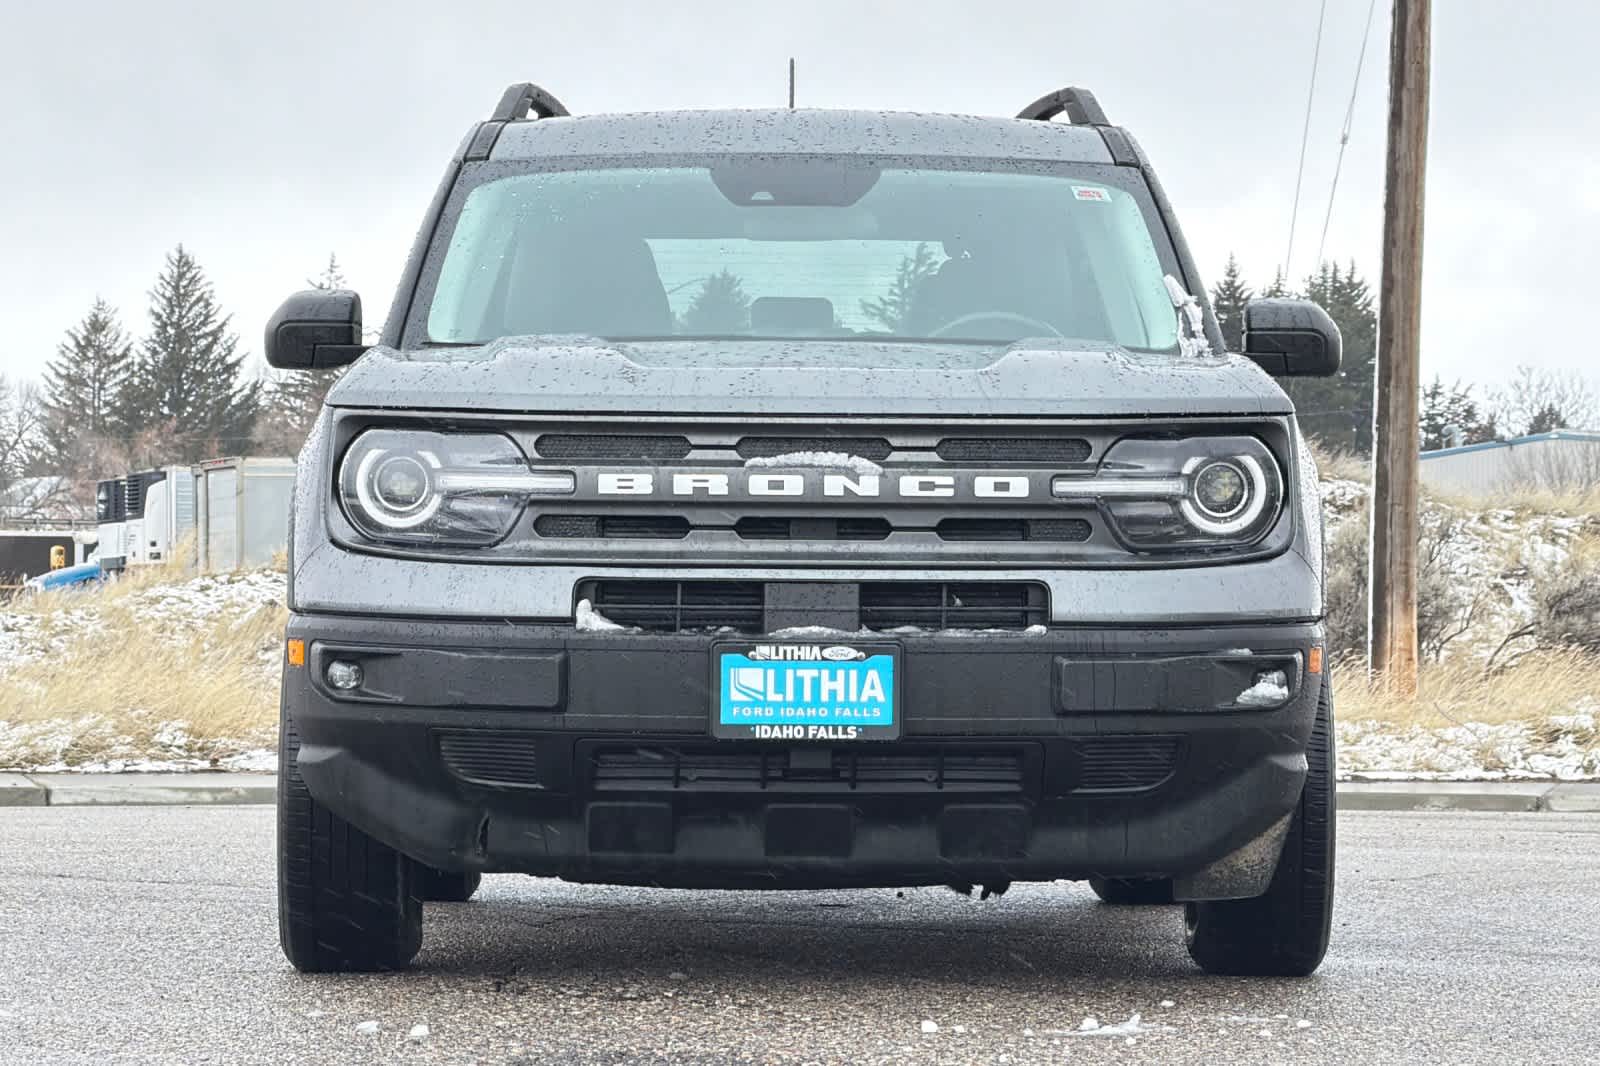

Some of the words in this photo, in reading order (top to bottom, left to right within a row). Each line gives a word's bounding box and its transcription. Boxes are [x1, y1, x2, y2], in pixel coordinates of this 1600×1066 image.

[598, 473, 1029, 498] BRONCO
[770, 646, 822, 660] LITHIA
[766, 668, 886, 703] LITHIA
[733, 707, 774, 717] FORD
[780, 707, 828, 717] IDAHO
[835, 707, 881, 717] FALLS
[755, 725, 804, 739] IDAHO
[808, 725, 857, 739] FALLS
